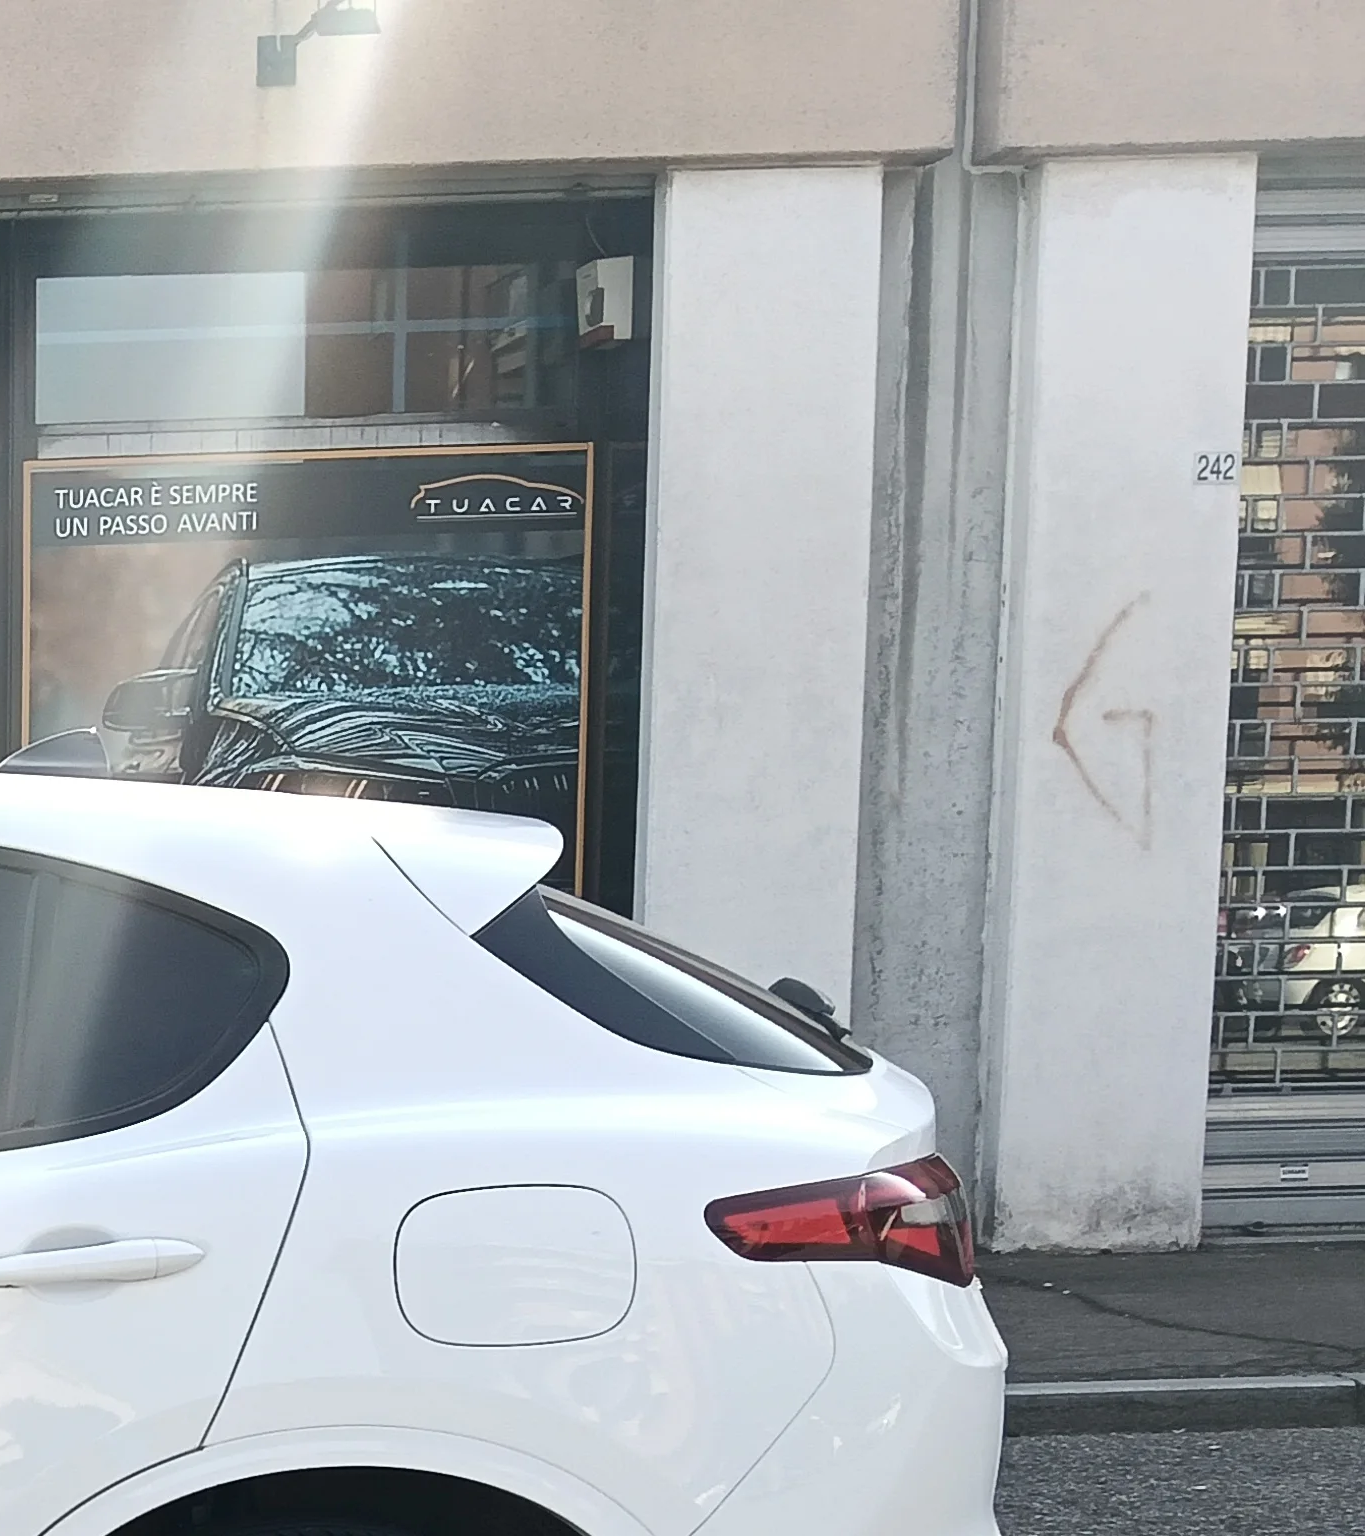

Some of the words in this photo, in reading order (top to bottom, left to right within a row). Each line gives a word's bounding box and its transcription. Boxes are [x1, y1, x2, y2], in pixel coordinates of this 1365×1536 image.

[1197, 453, 1235, 481] 242
[55, 487, 143, 510] TUACAR
[150, 481, 162, 507] È
[169, 482, 257, 506] SEMPRE
[425, 495, 574, 514] TUACAR
[55, 516, 88, 538] UN
[99, 513, 167, 536] PASSO
[177, 510, 257, 533] AVANTI
